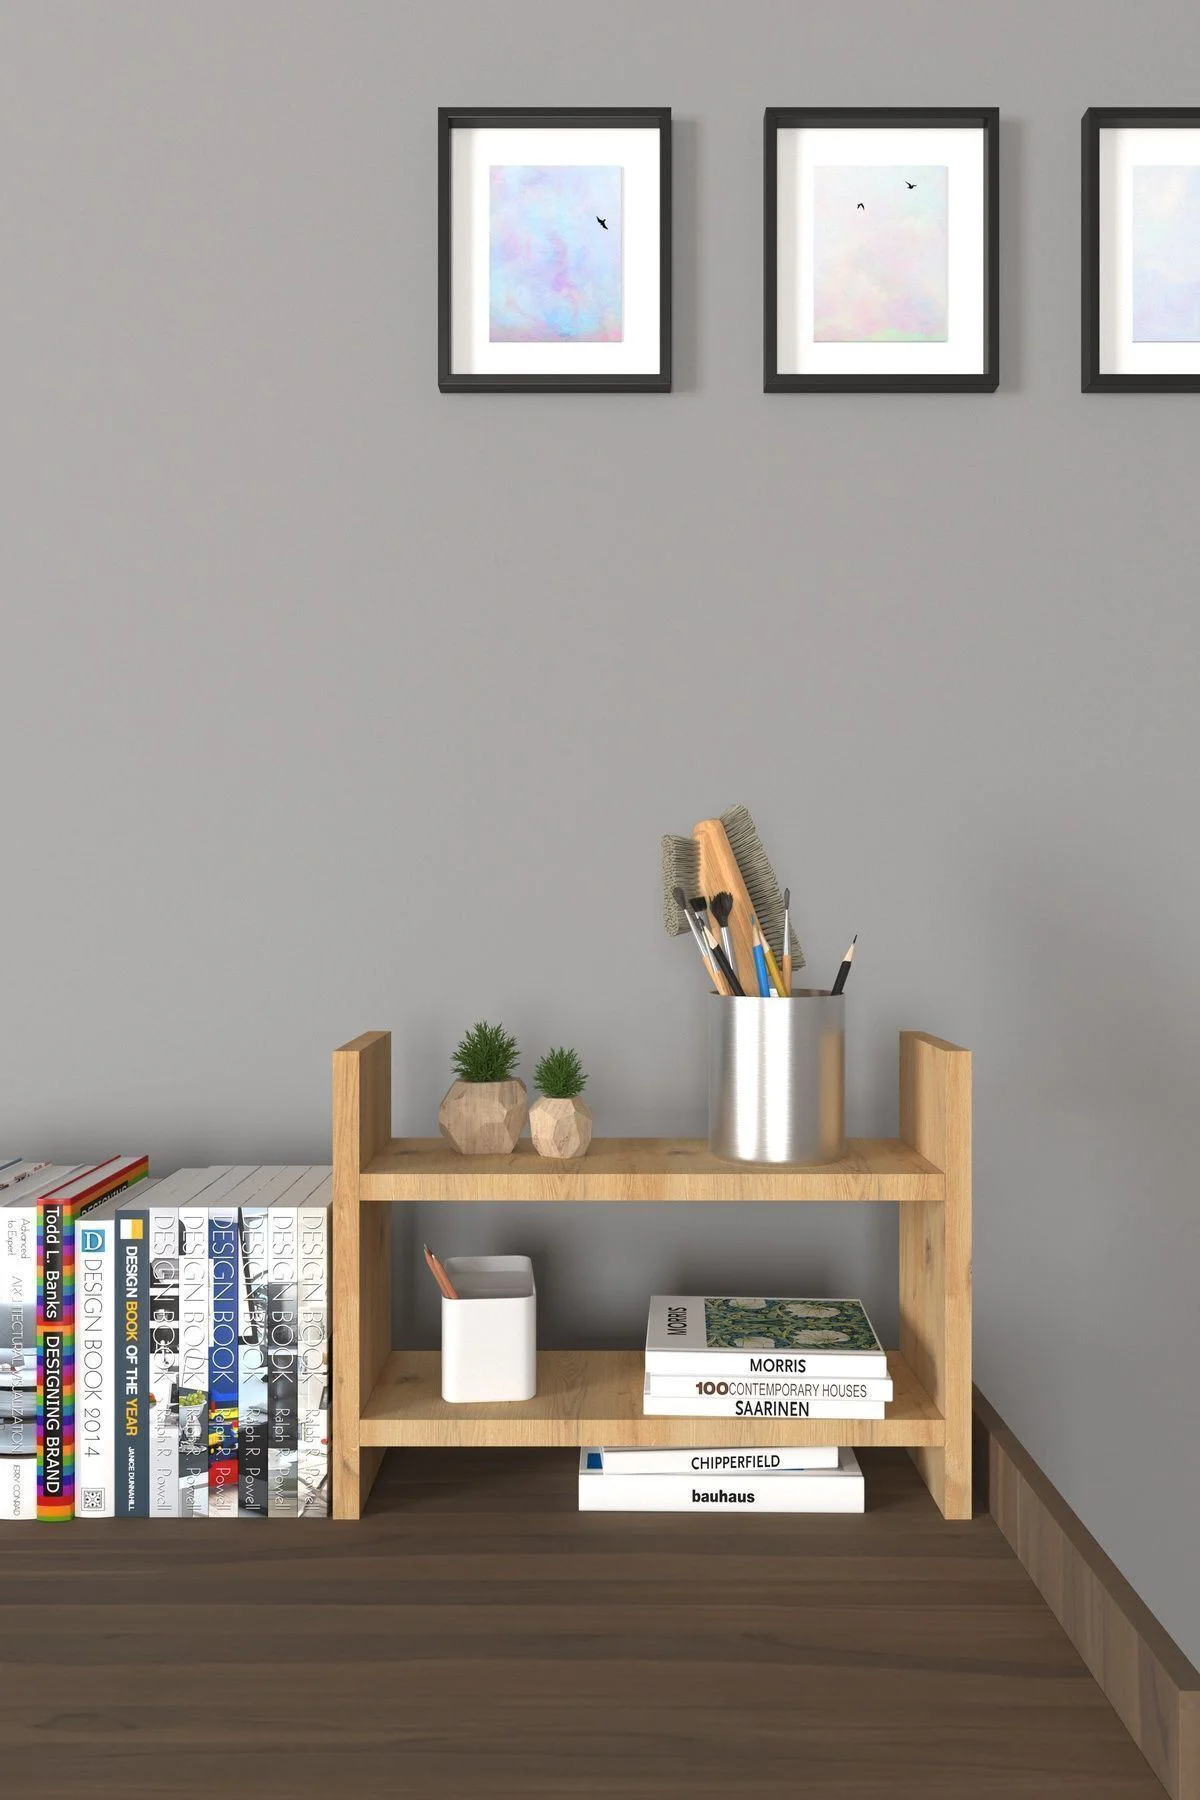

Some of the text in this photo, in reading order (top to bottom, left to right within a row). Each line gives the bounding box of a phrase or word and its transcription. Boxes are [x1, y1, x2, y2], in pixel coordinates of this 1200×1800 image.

[6, 1230, 17, 1255] Expert
[20, 1218, 30, 1259] Advanced
[85, 1232, 102, 1251] D
[46, 1206, 60, 1318] Todd L. Banks
[153, 1215, 175, 1384] DESIGN BOOK
[183, 1215, 205, 1384] DESIGN BOOK
[213, 1215, 234, 1384] DESIGN BOOK
[242, 1215, 264, 1384] DESIGN BOOK
[272, 1215, 294, 1384] DESIGN BOOK
[301, 1215, 323, 1384] DESIGN BOOK
[125, 1246, 138, 1436] DESIGN BOOK OF THE YEAR
[668, 1307, 686, 1336] MORRIS
[84, 1259, 102, 1457] DESIGN BOOK 2014
[750, 1359, 806, 1372] MORRIS
[735, 1401, 809, 1417] SAARINEN
[822, 1384, 867, 1397] HOUSES
[46, 1336, 59, 1493] DESIGNING BRAND
[156, 1408, 171, 1442] Ralph
[186, 1408, 201, 1442] Ralph
[215, 1408, 231, 1442] Ralph
[245, 1408, 260, 1442] Ralph
[275, 1408, 290, 1442] Ralph
[304, 1408, 320, 1442] Ralph
[691, 1455, 780, 1470] CHIPPERFIELD
[156, 1468, 171, 1511] Powell
[186, 1468, 201, 1511] Powell
[216, 1468, 231, 1511] Powell
[245, 1468, 260, 1511] Powell
[275, 1468, 290, 1511] Powell
[305, 1468, 320, 1511] Powell
[692, 1489, 755, 1503] bauhaus
